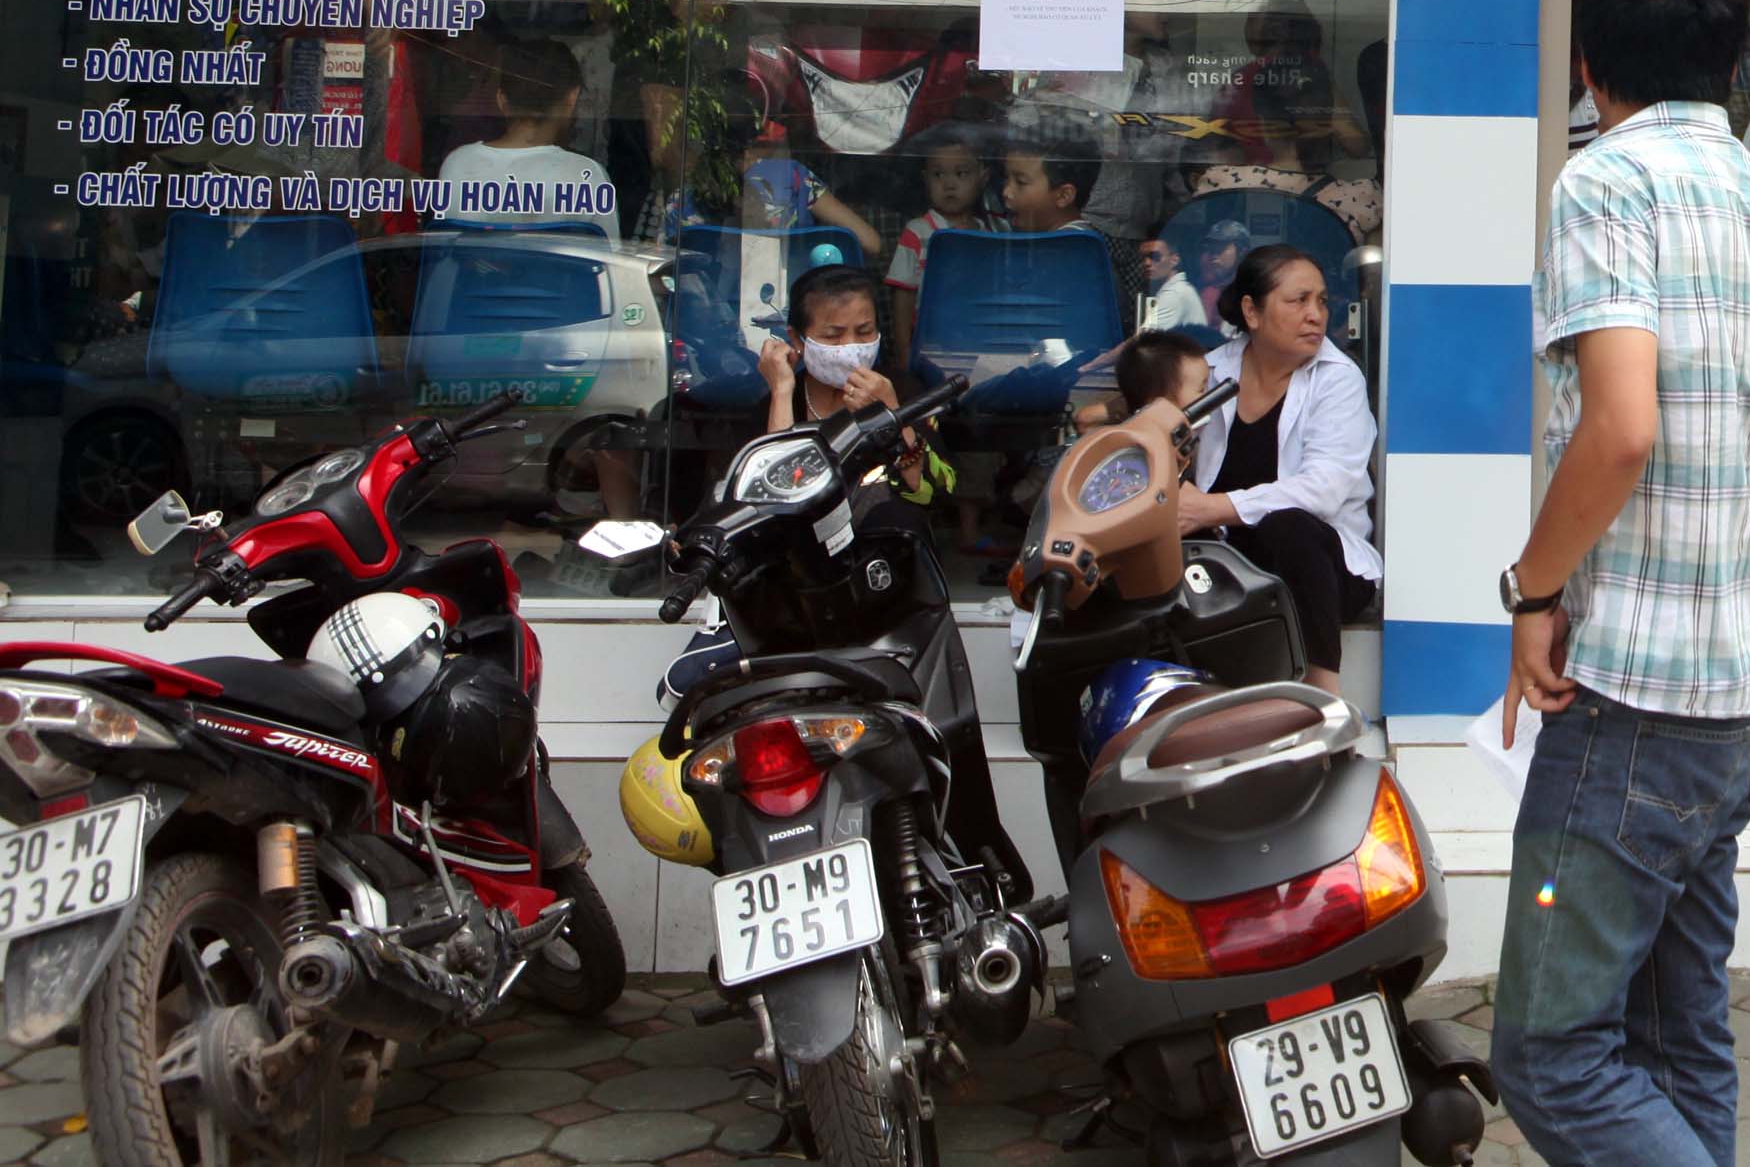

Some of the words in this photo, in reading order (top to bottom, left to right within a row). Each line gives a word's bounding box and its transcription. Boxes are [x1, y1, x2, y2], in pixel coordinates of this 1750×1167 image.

[84, 37, 174, 83] ĐỒNG
[180, 40, 267, 85] NHẤT
[79, 98, 137, 144] ĐỐI
[143, 103, 205, 145] TÁC
[211, 105, 256, 146] CÓ
[263, 112, 306, 147] UY
[312, 107, 364, 148] TÍN
[77, 161, 161, 207] CHẤT
[166, 171, 273, 216] LƯỢNG
[280, 170, 322, 211] VÀ
[329, 178, 403, 218] DỊCH
[410, 178, 452, 220] VỤ
[460, 173, 545, 214] HOÀN
[552, 169, 616, 215] HẢO
[1, 807, 121, 880] 30-M7
[768, 824, 815, 842] HONDA
[0, 859, 113, 931] 3328
[735, 853, 851, 921] 30-M9
[740, 899, 855, 971] 7651
[1256, 1009, 1370, 1088] 29-V9
[1270, 1063, 1386, 1140] 6609
